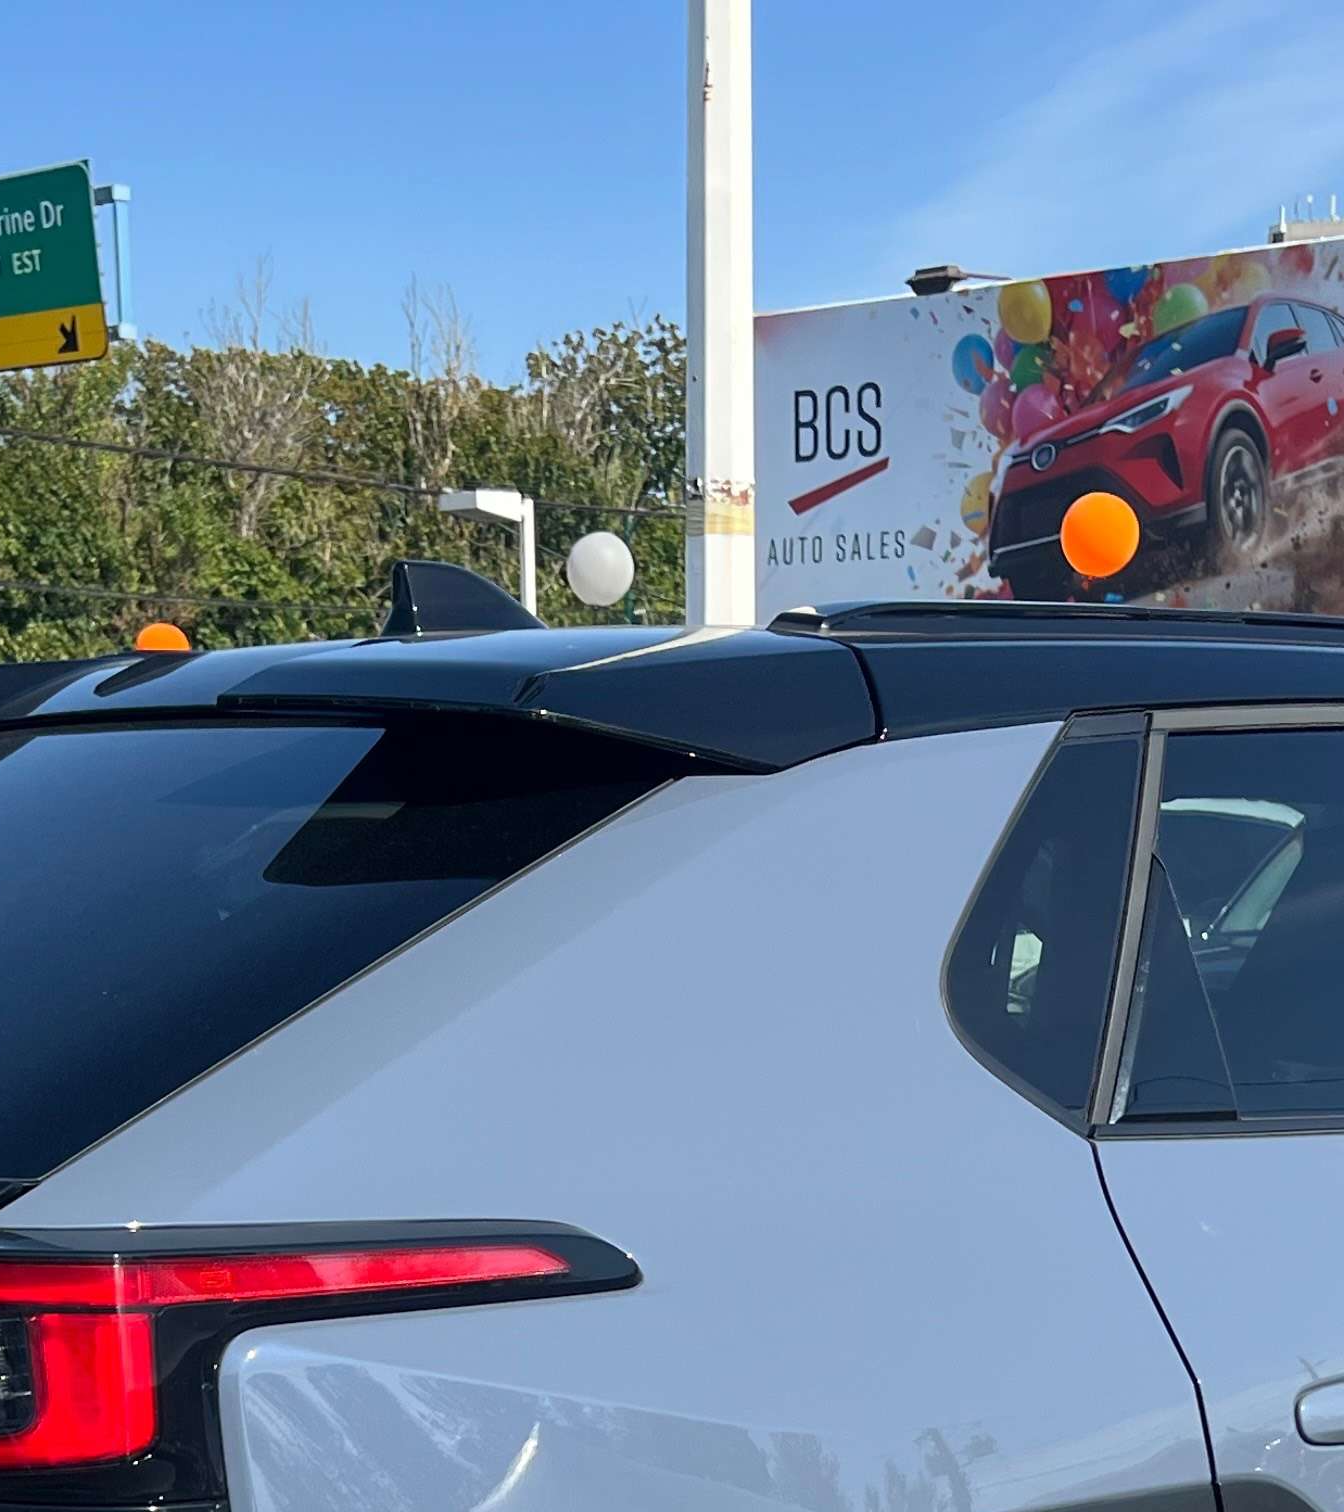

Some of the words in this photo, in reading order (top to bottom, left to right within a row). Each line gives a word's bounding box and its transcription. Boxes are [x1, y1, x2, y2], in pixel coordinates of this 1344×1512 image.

[39, 200, 64, 229] Dr
[11, 249, 41, 275] EST
[793, 382, 882, 463] BCS
[767, 535, 823, 567] AUTO
[835, 529, 906, 563] SALES
